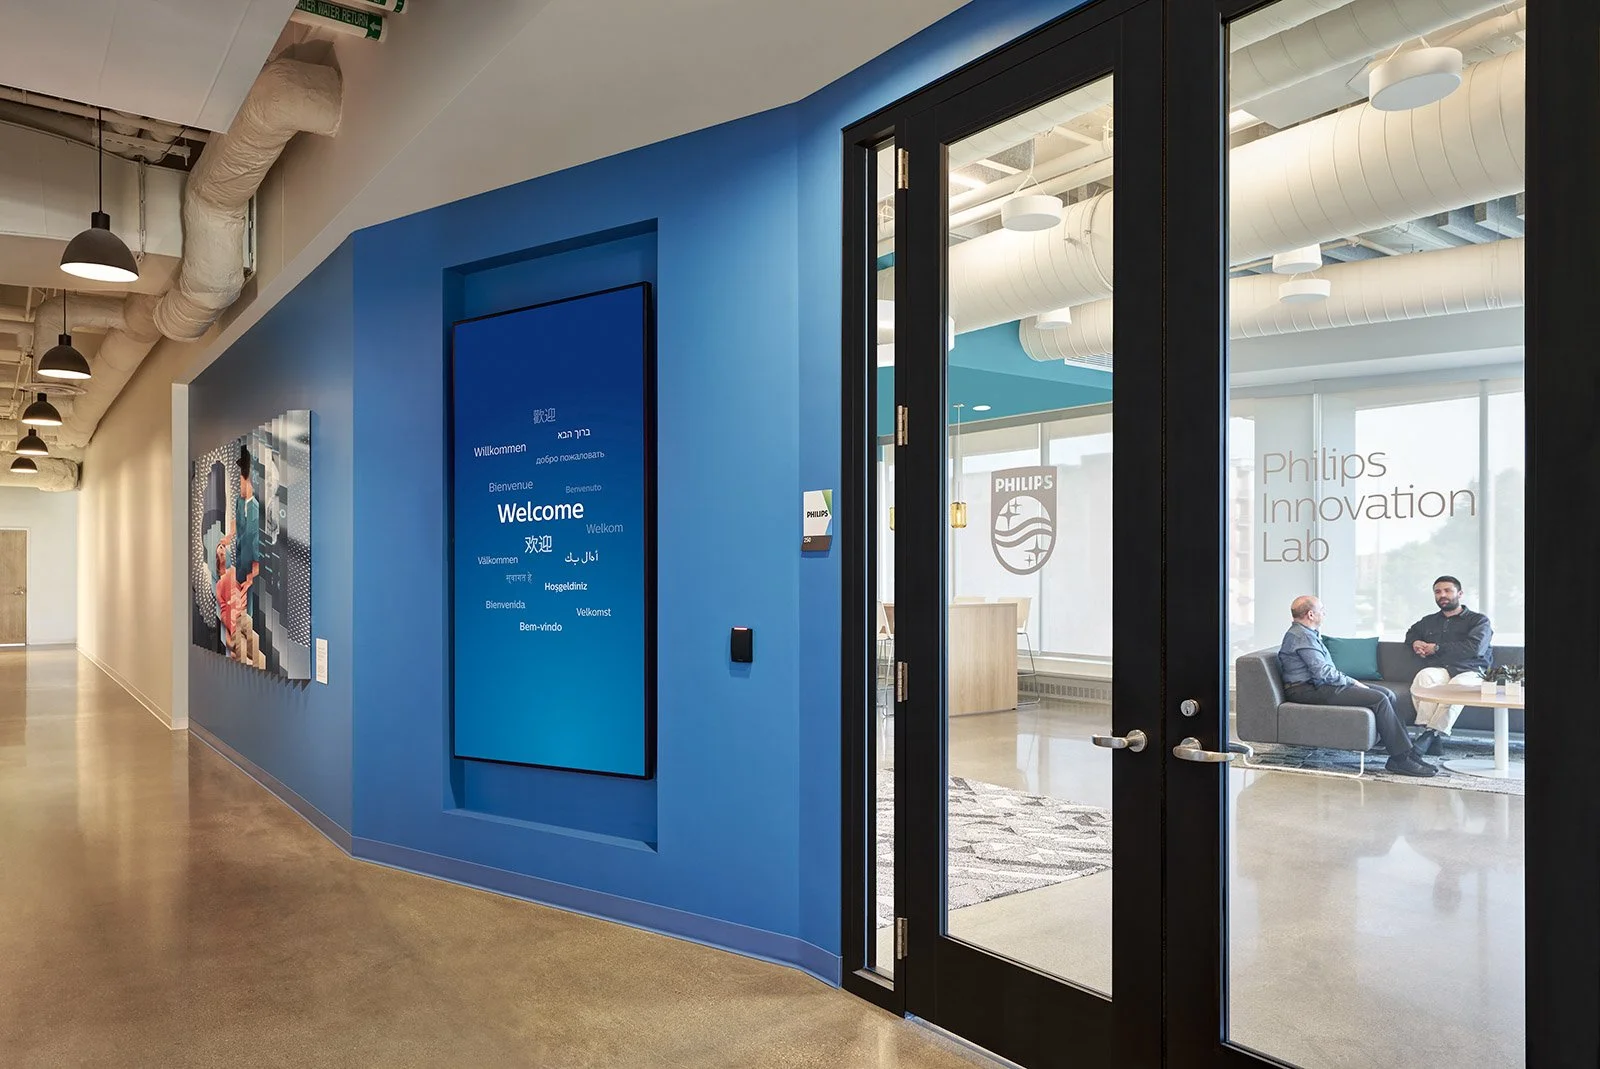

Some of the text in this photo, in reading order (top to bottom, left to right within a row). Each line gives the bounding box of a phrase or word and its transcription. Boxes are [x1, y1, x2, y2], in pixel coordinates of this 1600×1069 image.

[318, 2, 340, 19] WATER
[341, 6, 369, 28] RETURN
[557, 428, 591, 440] ברוך הבא
[473, 443, 527, 457] Willkommen
[535, 451, 605, 465] добро пожаловать
[1263, 447, 1387, 487] Philips
[488, 480, 534, 493] Bienvenue
[565, 484, 602, 494] Benvenuto
[995, 474, 1054, 493] PHILIPS
[1263, 484, 1476, 524] Innovation
[497, 501, 584, 524] Welcome
[806, 509, 829, 519] PHILIPS
[586, 523, 624, 534] Welkom
[524, 534, 553, 554] 欢迎
[1263, 528, 1330, 563] Lab
[477, 556, 519, 565] Välkommen
[544, 581, 588, 593] Hoşgeldiniz
[485, 600, 526, 609] Bienvenida
[576, 607, 612, 617] Velkomst
[519, 621, 563, 632] Bem-vindo
